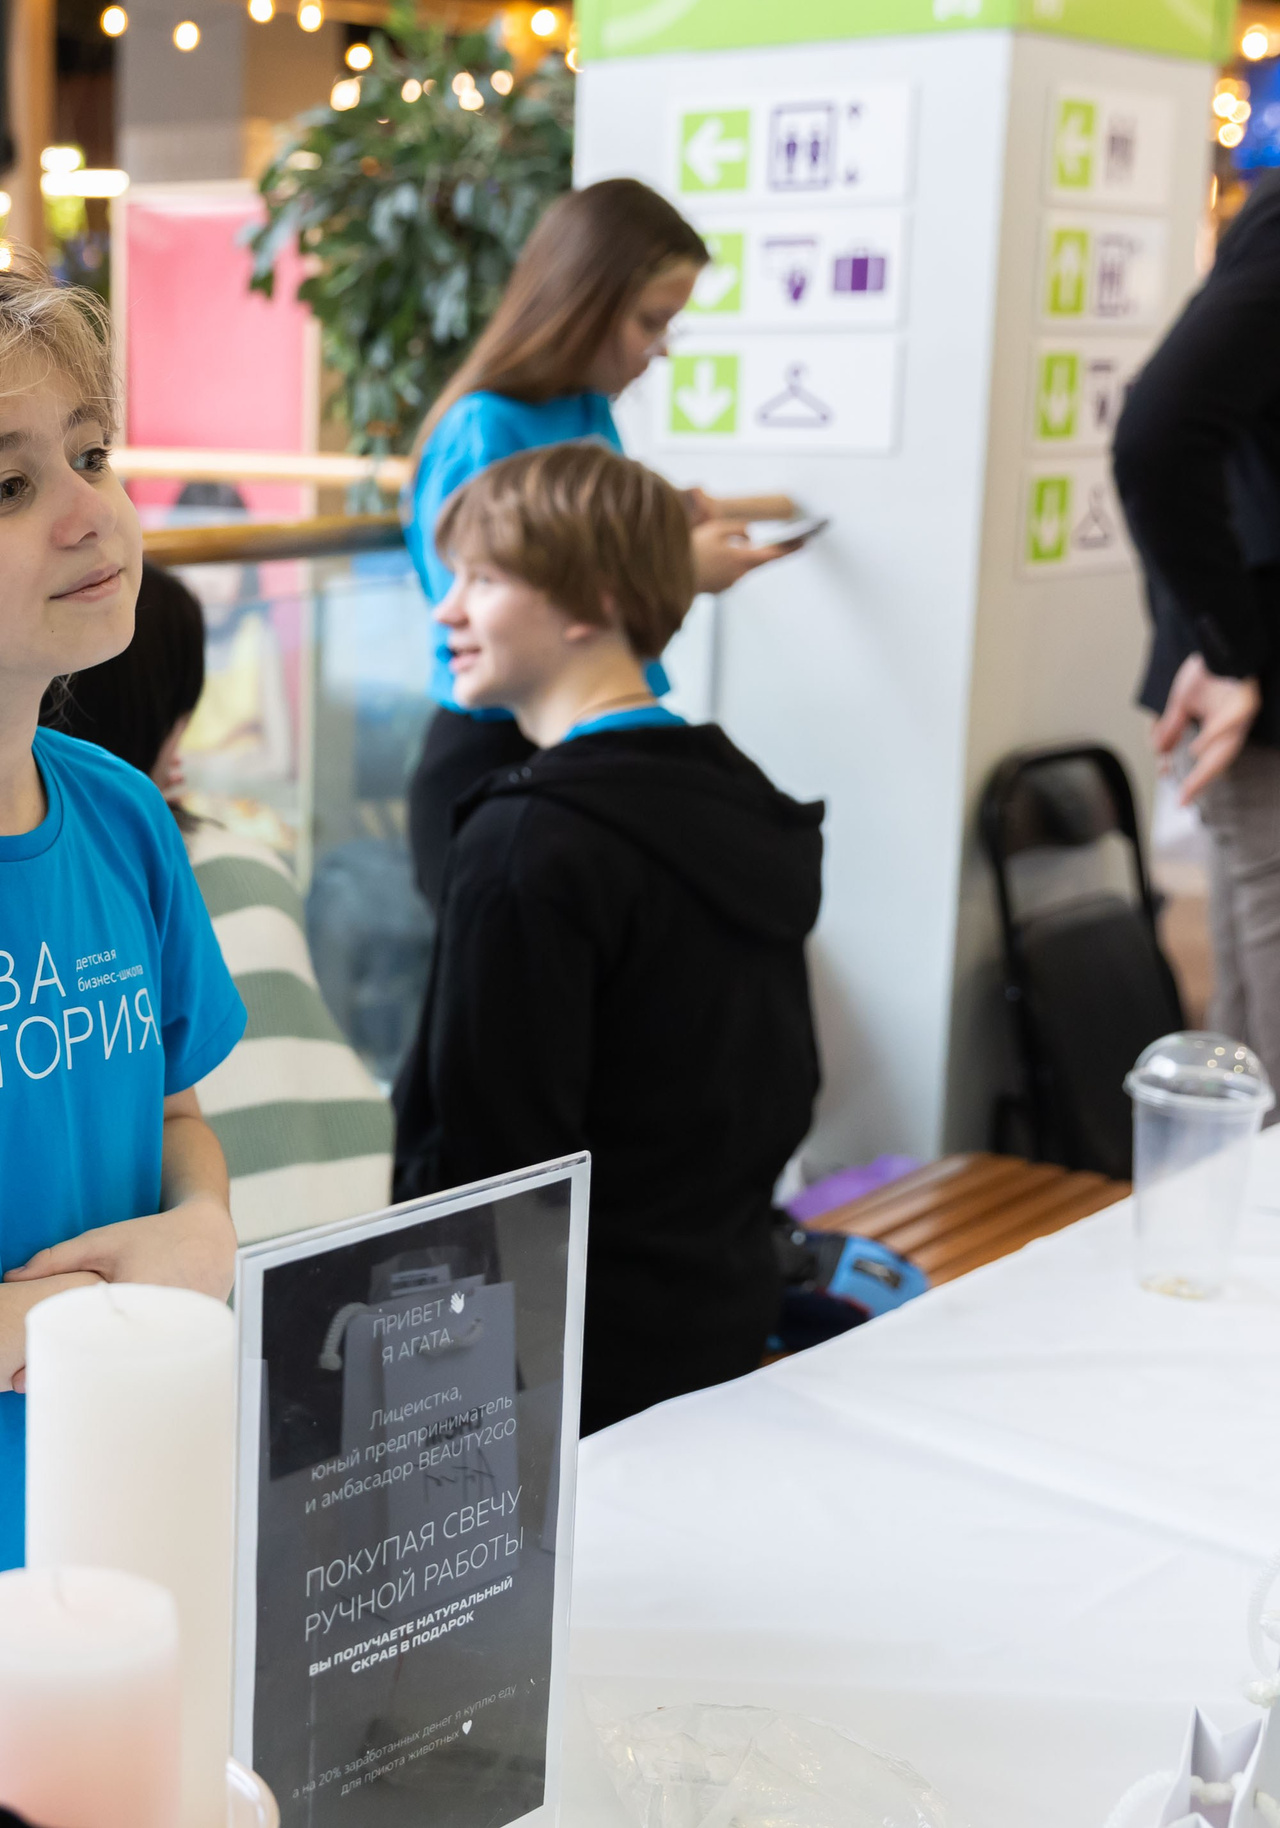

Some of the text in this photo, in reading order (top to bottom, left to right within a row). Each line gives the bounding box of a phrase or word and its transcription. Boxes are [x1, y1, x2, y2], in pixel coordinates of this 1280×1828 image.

[75, 948, 116, 971] детская
[77, 964, 144, 992] бизнес-школа
[373, 1299, 444, 1338] ПРИВЕТ
[382, 1328, 454, 1365] Я АГАТА.
[311, 1450, 360, 1482] юный
[365, 1396, 513, 1462] предприниматель
[370, 1386, 462, 1431] Лицеистка,
[305, 1499, 316, 1515] и
[321, 1461, 414, 1507] амбасадор
[419, 1418, 517, 1471] BEAUTY2GO
[306, 1485, 523, 1597] ПОКУПАЯ СВЕЧУ
[305, 1526, 524, 1642] РУЧНОЙ РАБОТЫ
[309, 1575, 513, 1677] ВЫ ПОЛУЧАЕТЕ НАТУРАЛЬНЫЙ
[350, 1610, 475, 1674] СКРАБ В ПОДАРОК
[302, 1780, 316, 1794] на
[319, 1765, 342, 1786] 20%
[344, 1731, 421, 1775] заработанных
[422, 1715, 453, 1738] денег
[463, 1694, 496, 1717] куплю
[498, 1684, 518, 1700] еду
[340, 1730, 460, 1796] для приюта животных
